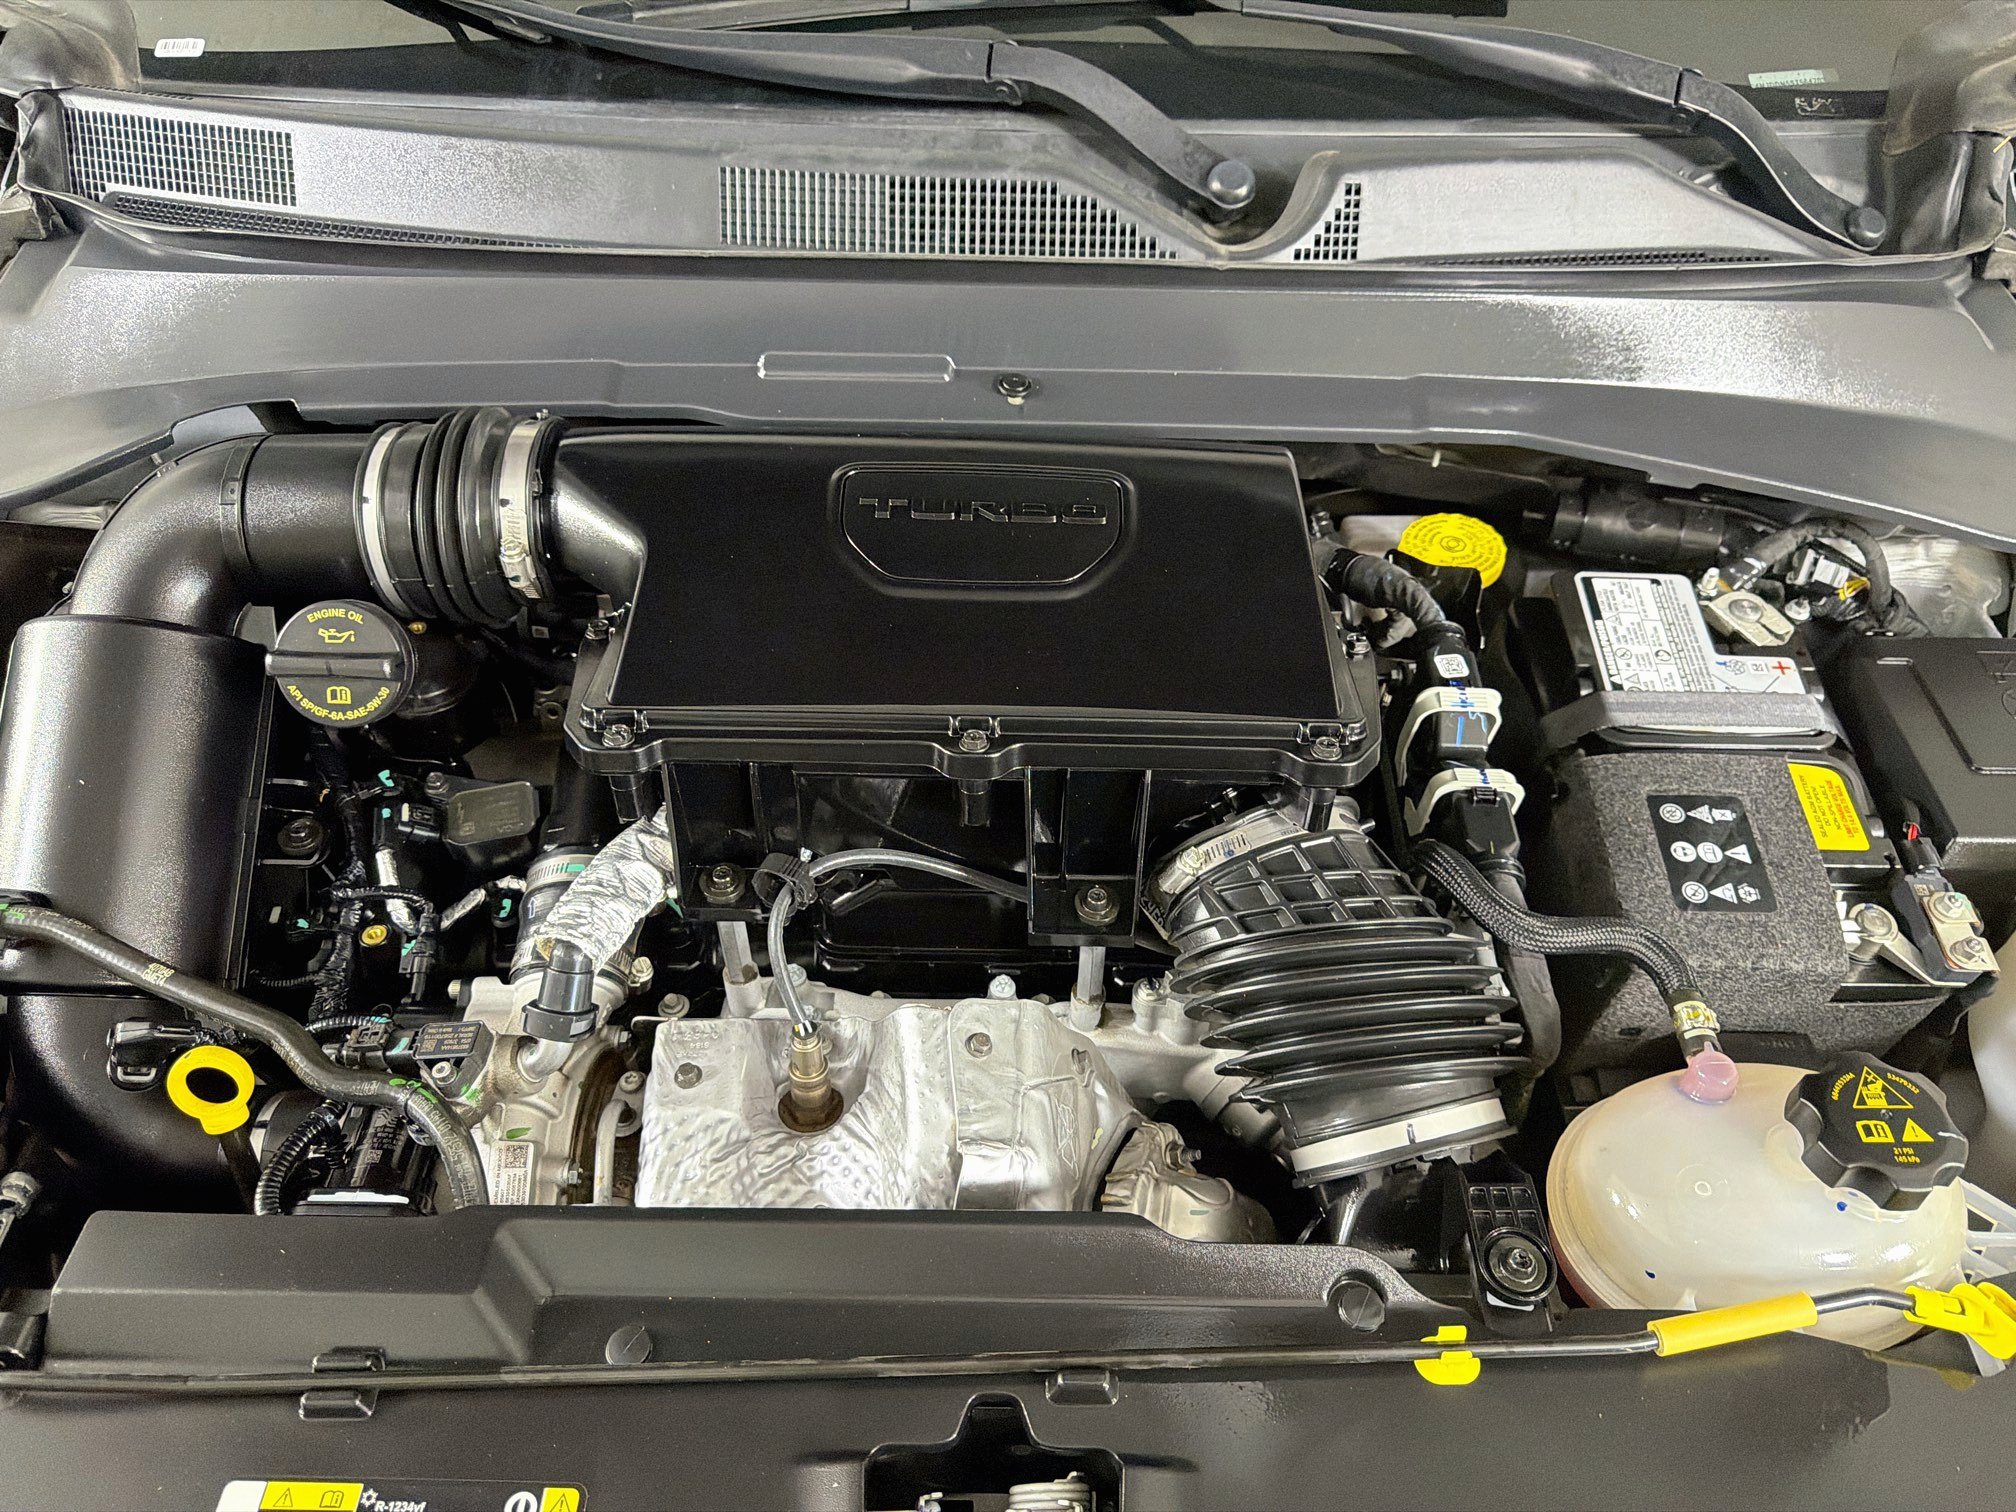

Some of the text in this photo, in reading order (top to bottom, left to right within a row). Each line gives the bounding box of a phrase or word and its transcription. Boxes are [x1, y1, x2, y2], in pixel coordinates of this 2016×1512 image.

[859, 496, 1108, 525] TURBO
[306, 608, 364, 625] ENGINE OIL
[287, 684, 302, 701] API
[1799, 775, 1828, 837] SEALED AGM BATTERY
[1817, 805, 1826, 815] NOT
[1835, 803, 1847, 821] CHARGE
[1893, 1147, 1915, 1155] 21 PSI
